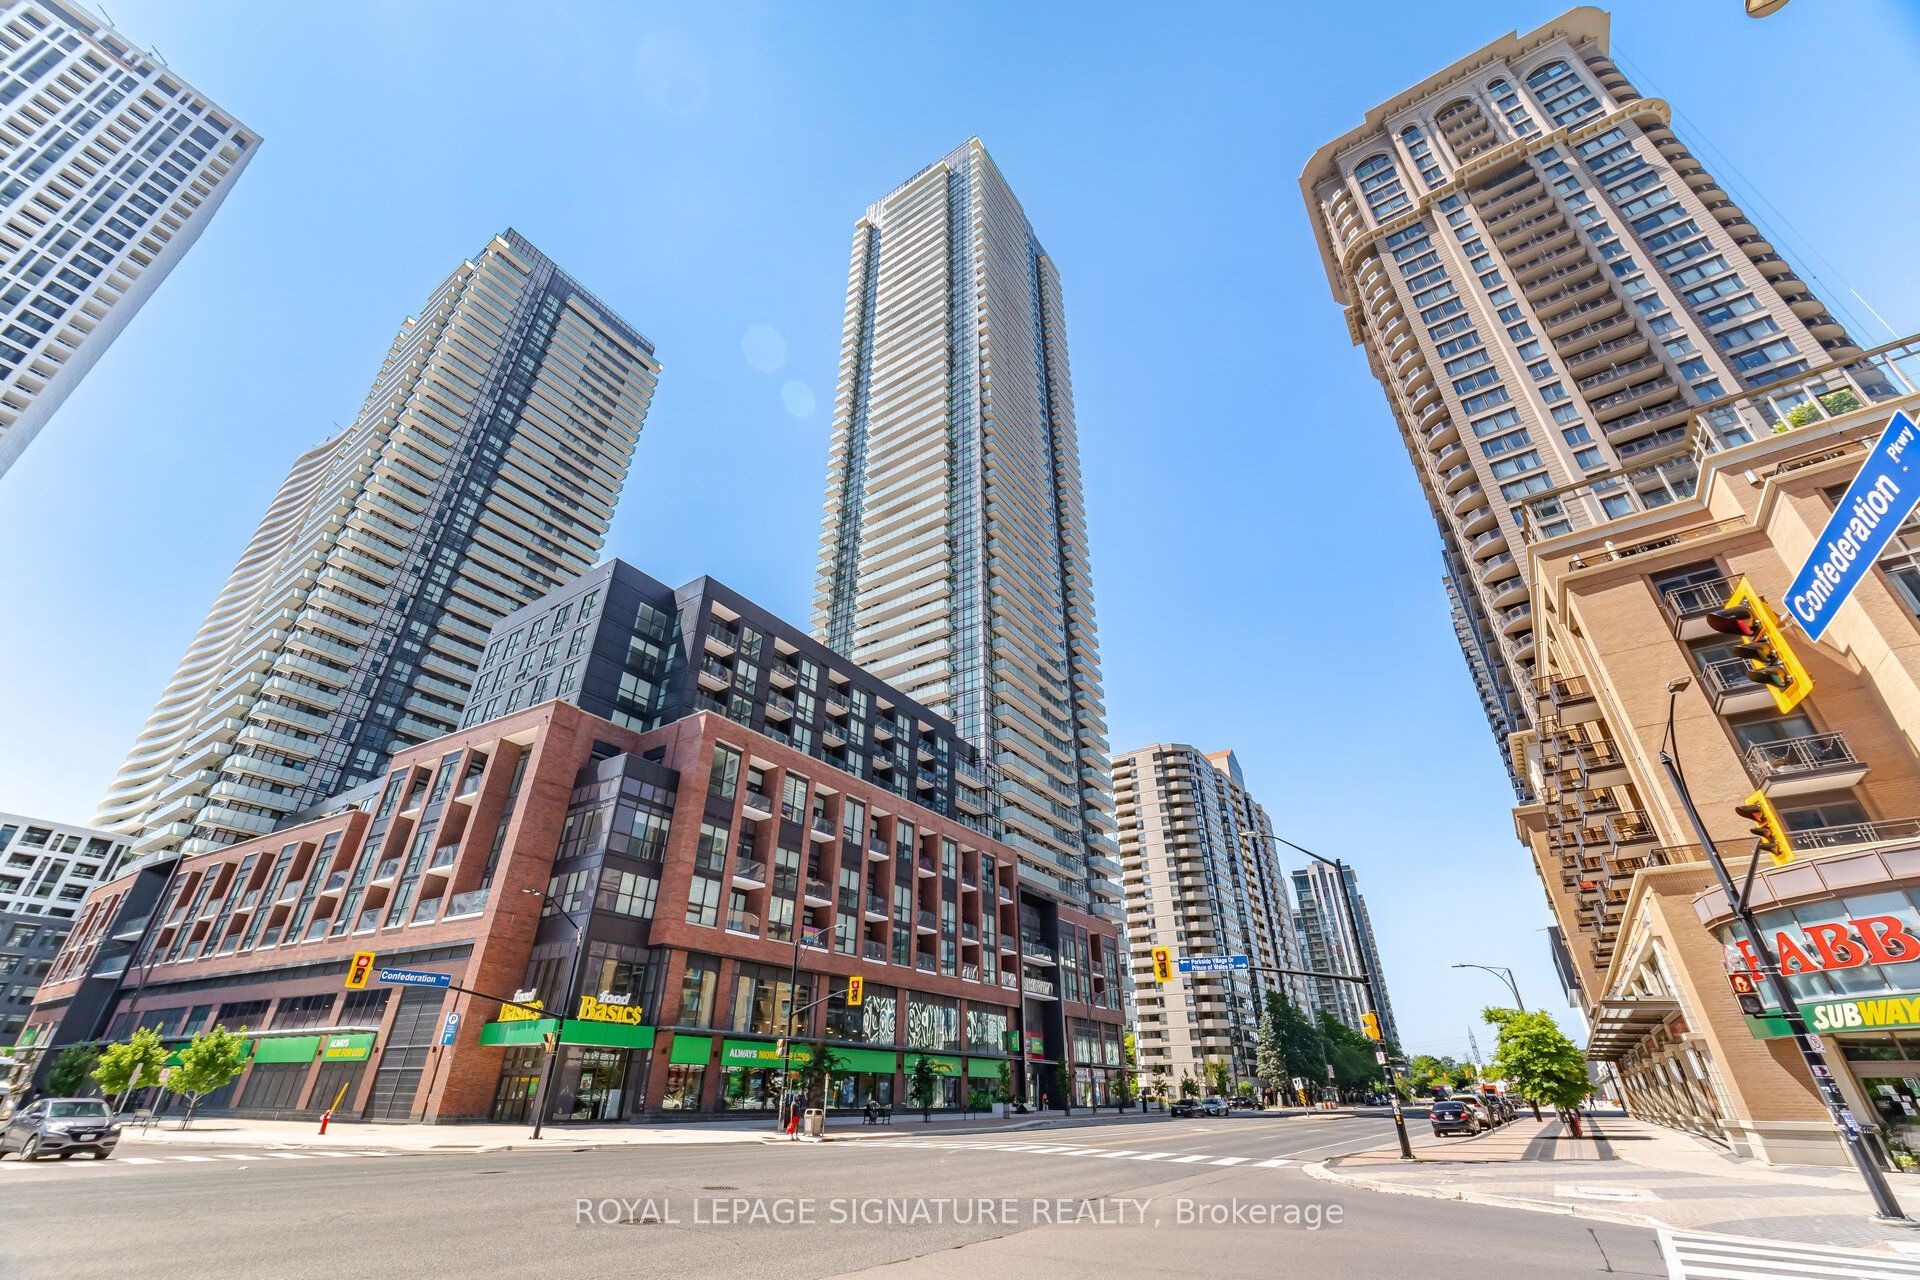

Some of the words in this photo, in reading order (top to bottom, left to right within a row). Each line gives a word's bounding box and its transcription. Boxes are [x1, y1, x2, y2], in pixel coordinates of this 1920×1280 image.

[1794, 474, 1900, 622] Confederation
[1886, 425, 1915, 461] Pkwy
[381, 971, 437, 983] Confederation
[512, 988, 537, 1002] food
[598, 989, 631, 1005] food
[1813, 997, 1920, 1030] SUBWAY
[728, 1048, 757, 1058] ALWAYS
